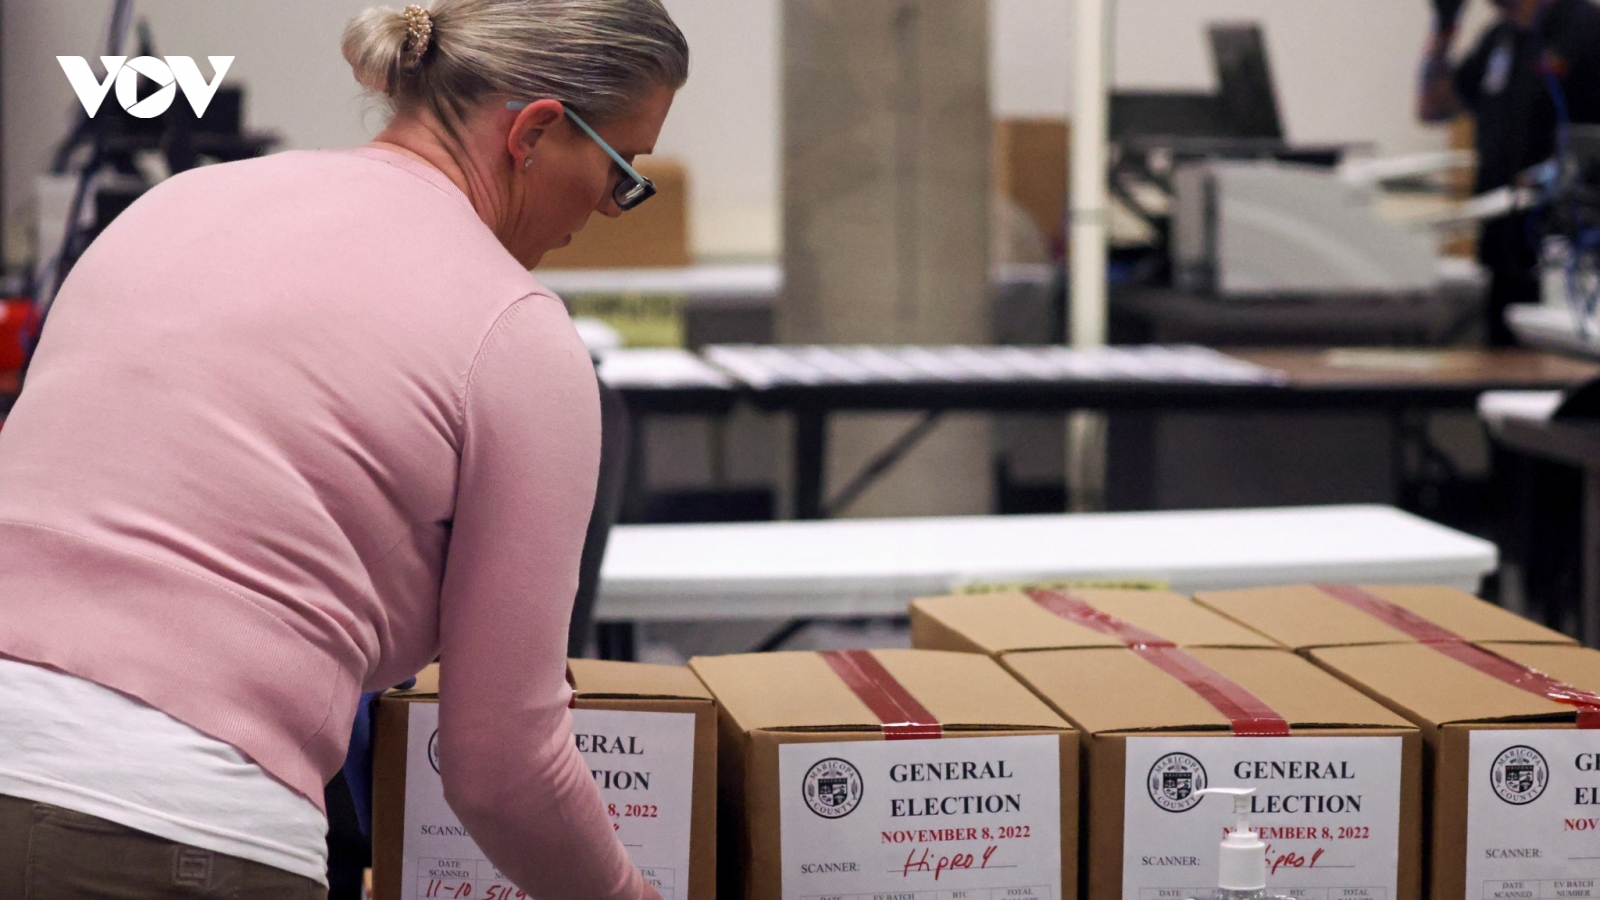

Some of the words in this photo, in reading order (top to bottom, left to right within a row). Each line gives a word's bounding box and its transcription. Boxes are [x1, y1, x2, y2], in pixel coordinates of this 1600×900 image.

[575, 734, 645, 755] ERAL
[1155, 756, 1200, 774] MARICOPA
[1497, 749, 1541, 767] MARICOPA
[810, 761, 855, 780] MARICOPA
[889, 760, 1013, 783] GENERAL
[1234, 760, 1356, 780] GENERAL
[590, 770, 651, 790] TION
[1501, 788, 1538, 801] COUNTY
[813, 801, 853, 815] COUNTY
[890, 794, 1022, 818] ELECTION
[1157, 795, 1197, 809] COUNTY
[1233, 795, 1363, 813] LECTION
[607, 803, 620, 818] 8,
[624, 804, 658, 818] 2022
[420, 825, 470, 837] SCANNE
[881, 828, 977, 844] NOVEMBER
[982, 827, 994, 841] 8,
[998, 825, 1031, 839] 2022
[1222, 827, 1318, 840] NEMBER
[1321, 827, 1333, 841] 8,
[1338, 826, 1369, 839] 2022
[1485, 849, 1543, 858] SCANNER:
[438, 860, 460, 868] DATE
[801, 862, 860, 874] SCANNER:
[1141, 856, 1200, 866] SCANNER:
[429, 869, 469, 878] SCANNED
[641, 869, 656, 877] TAL
[1566, 880, 1595, 888] BATCH
[1007, 888, 1033, 896] TOTAL
